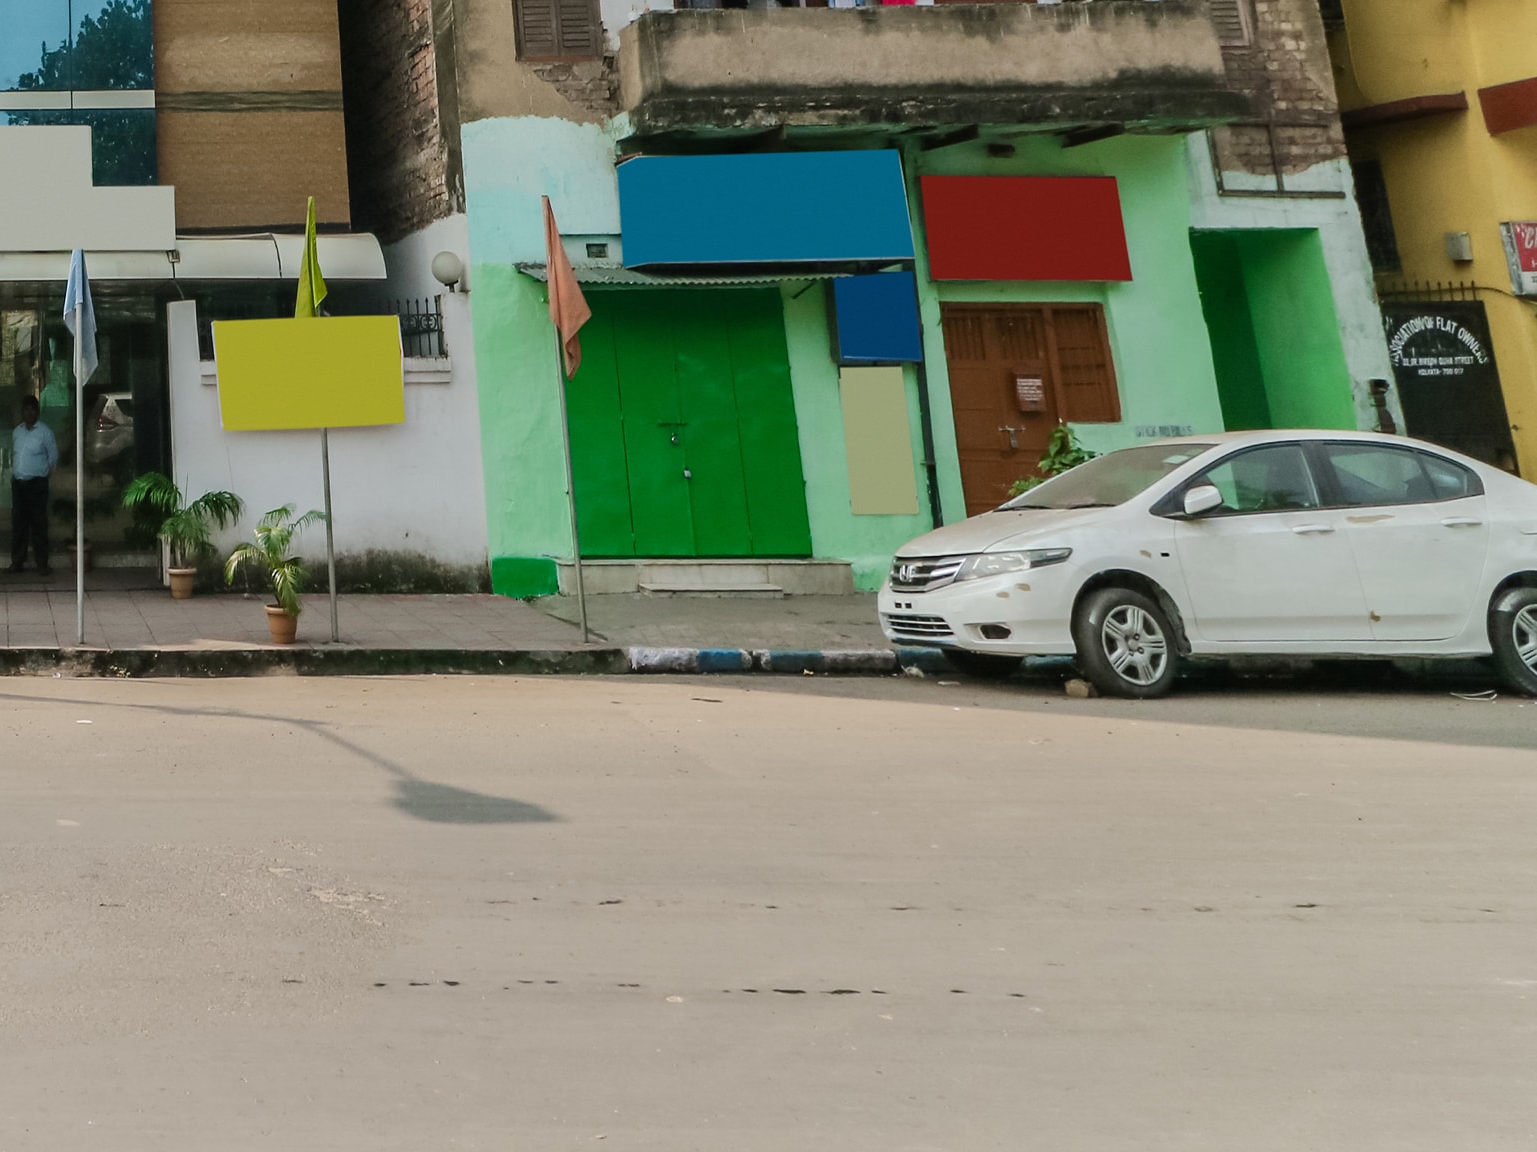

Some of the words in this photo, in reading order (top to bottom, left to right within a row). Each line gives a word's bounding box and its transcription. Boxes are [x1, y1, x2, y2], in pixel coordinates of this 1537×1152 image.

[1424, 316, 1434, 329] OF
[1436, 316, 1458, 334] FLAT
[1457, 327, 1489, 364] OWNERS
